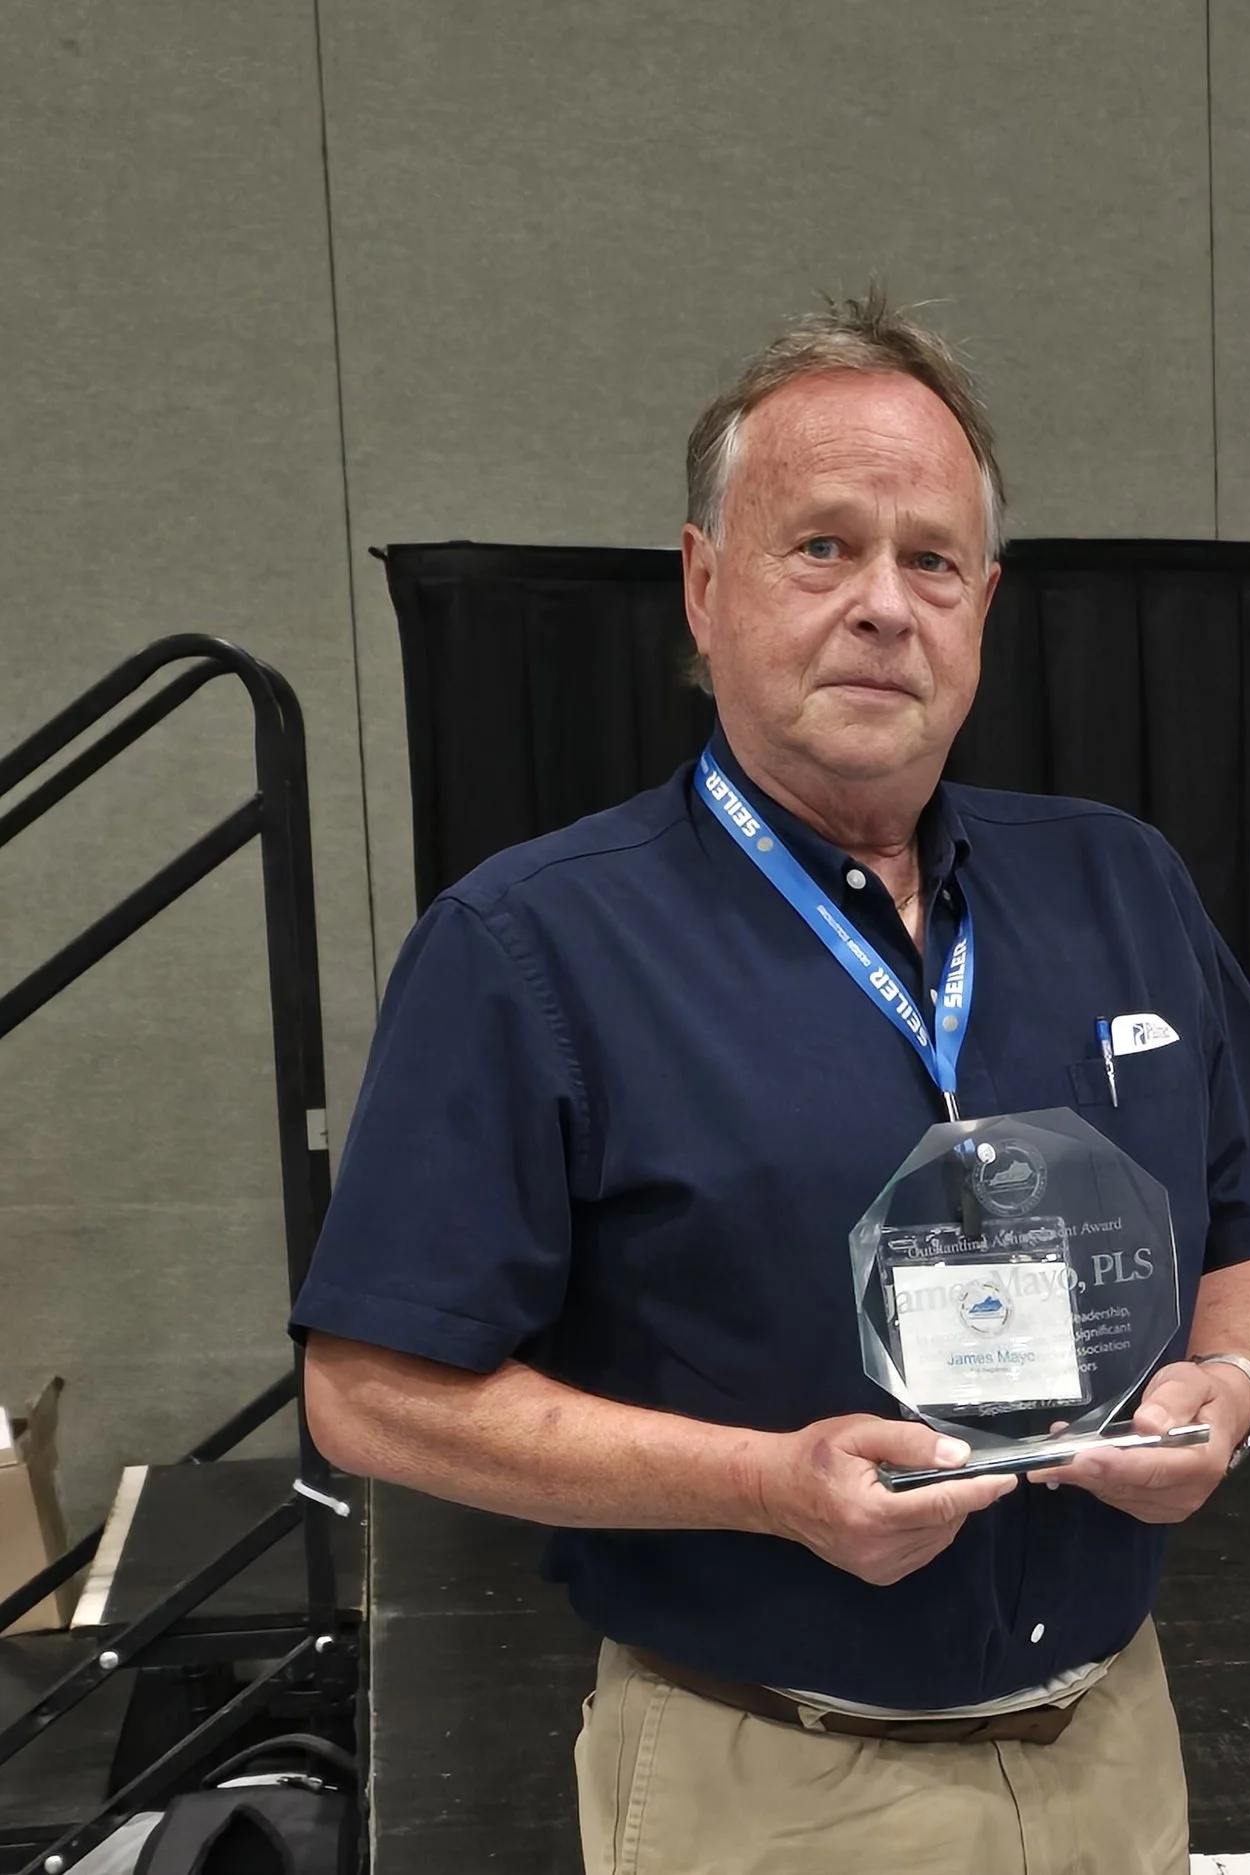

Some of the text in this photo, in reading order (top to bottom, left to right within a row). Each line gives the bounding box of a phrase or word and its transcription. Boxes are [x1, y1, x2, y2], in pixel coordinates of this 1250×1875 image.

[704, 770, 761, 838] SEILER
[943, 938, 967, 1009] SEILER
[868, 966, 928, 1047] SEILER
[991, 1225, 1077, 1249] Achient
[1080, 1217, 1122, 1235] Award
[991, 1265, 1086, 1298] Mayo,
[1092, 1248, 1154, 1286] PLS
[1074, 1306, 1131, 1324] eadership,
[947, 1352, 994, 1367] James
[997, 1349, 1036, 1366] Mayo
[1077, 1339, 1131, 1357] ssociation
